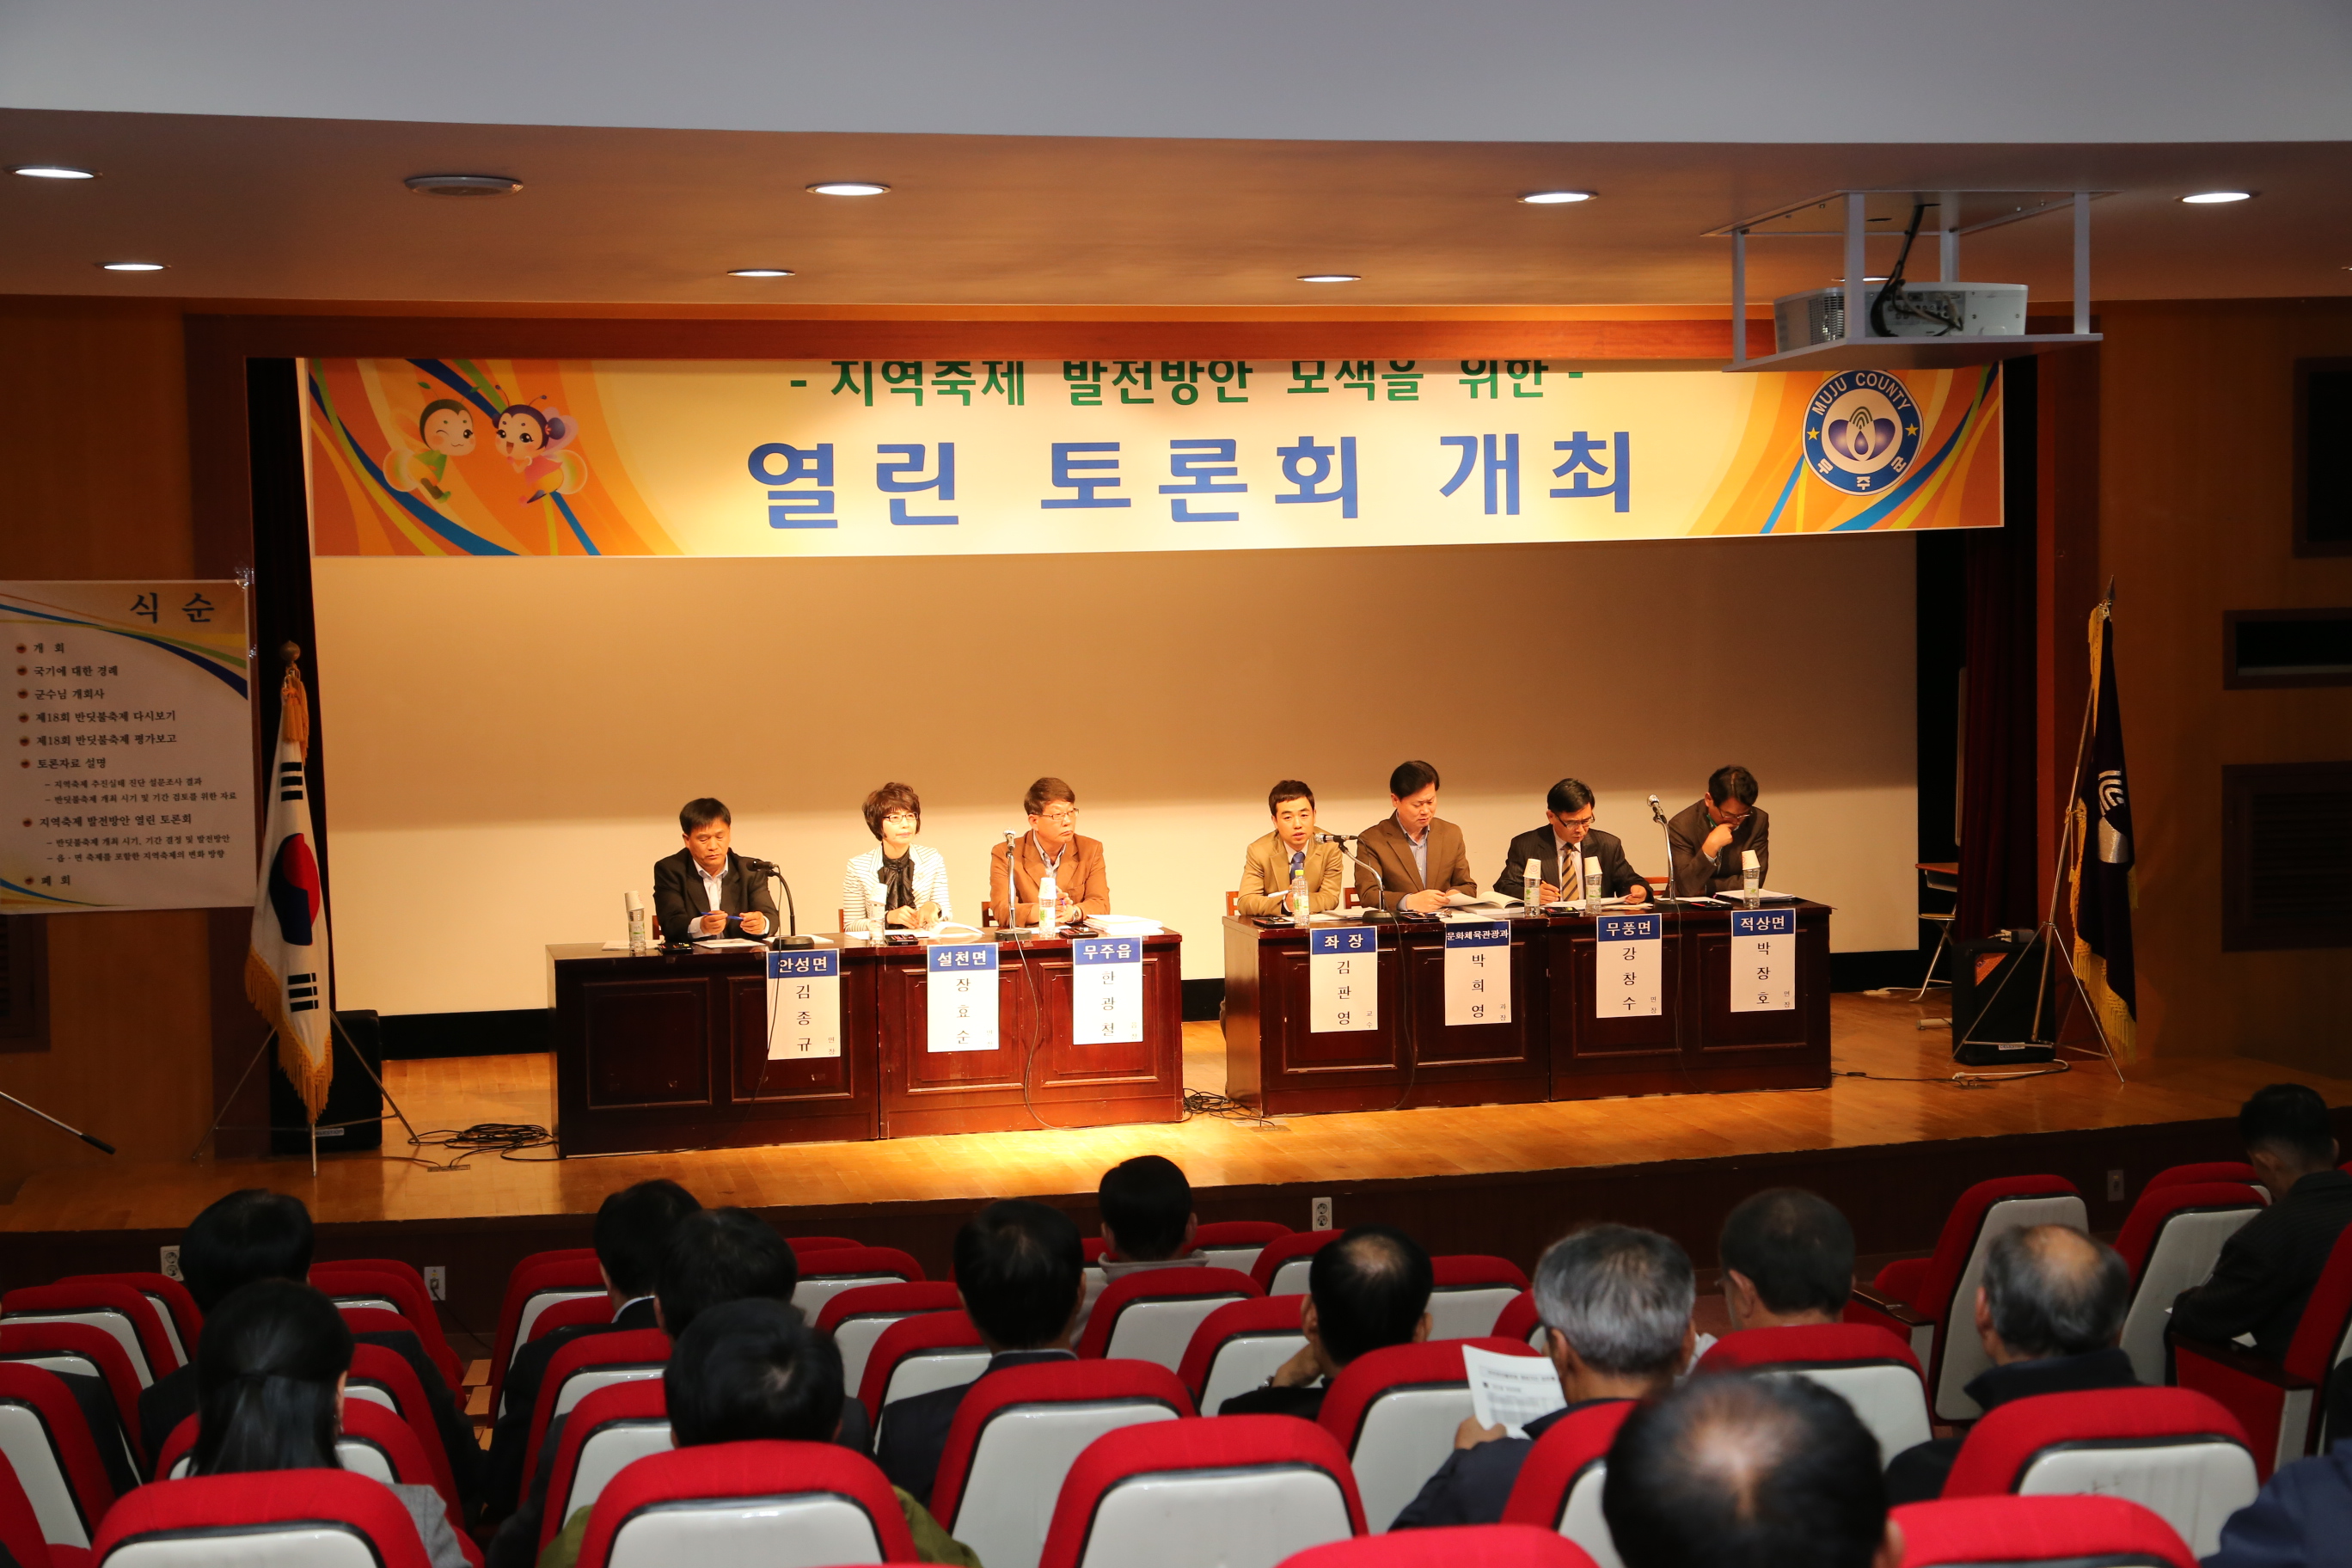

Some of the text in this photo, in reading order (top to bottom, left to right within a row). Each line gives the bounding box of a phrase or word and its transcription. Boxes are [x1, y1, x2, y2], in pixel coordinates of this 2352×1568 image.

[830, 361, 1025, 407] 지역축제
[1063, 361, 1253, 406] 발전방안
[1287, 360, 1424, 401] 모색을
[1459, 360, 1549, 399] 위한
[1811, 372, 1912, 416] MUJU COUNTY
[747, 431, 1631, 530] 열린 토론회 개최
[34, 665, 118, 677] 국기에 대한 경례
[34, 688, 105, 701] 군수님 개회사
[35, 710, 175, 724] 제18회 반딧불축제 다시보기
[36, 733, 177, 746] 제18회 반딧불축제 평가보고
[37, 756, 107, 769] 토론자료 설명
[40, 813, 192, 828] 지역축제 발전방안 열린 토론회
[1606, 921, 1651, 937] 무풍면
[1740, 916, 1785, 932] 적상면
[1446, 928, 1510, 941] 문화체육관광과
[937, 950, 986, 967] 설천면
[1082, 944, 1132, 960] 무주읍
[778, 956, 827, 973] 안성면
